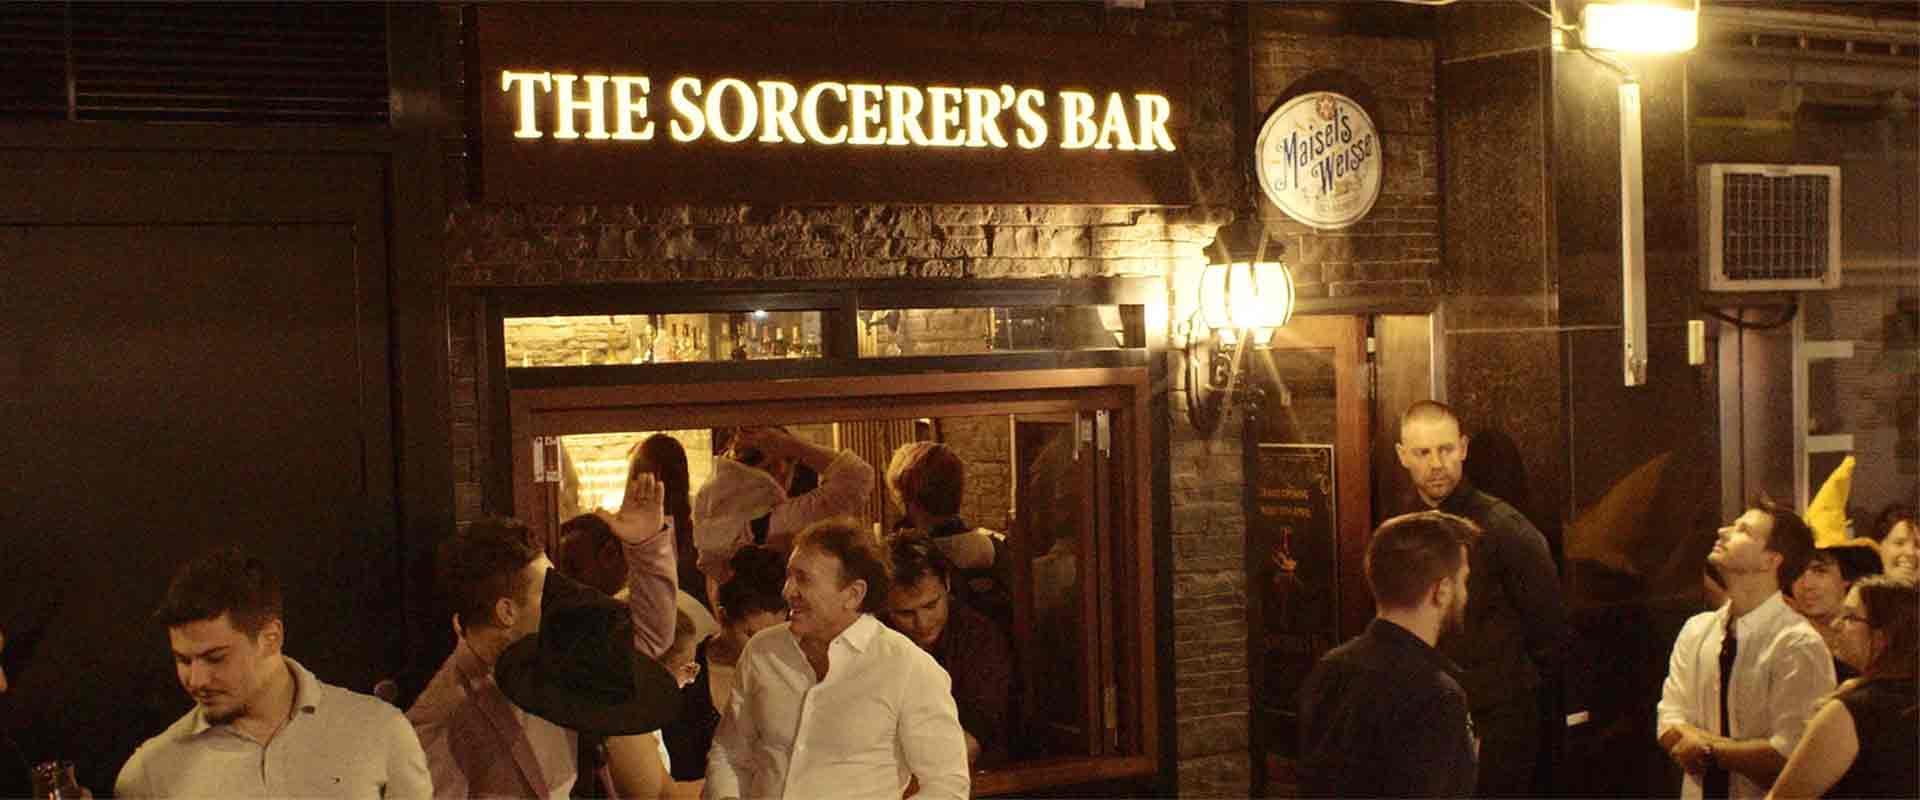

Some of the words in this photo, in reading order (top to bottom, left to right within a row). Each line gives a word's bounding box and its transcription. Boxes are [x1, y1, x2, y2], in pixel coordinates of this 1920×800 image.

[502, 70, 655, 140] THE
[668, 77, 1048, 150] SORCERER'S
[1059, 91, 1176, 152] BAR
[1275, 105, 1353, 192] Maisel's
[1311, 133, 1373, 195] Weisse
